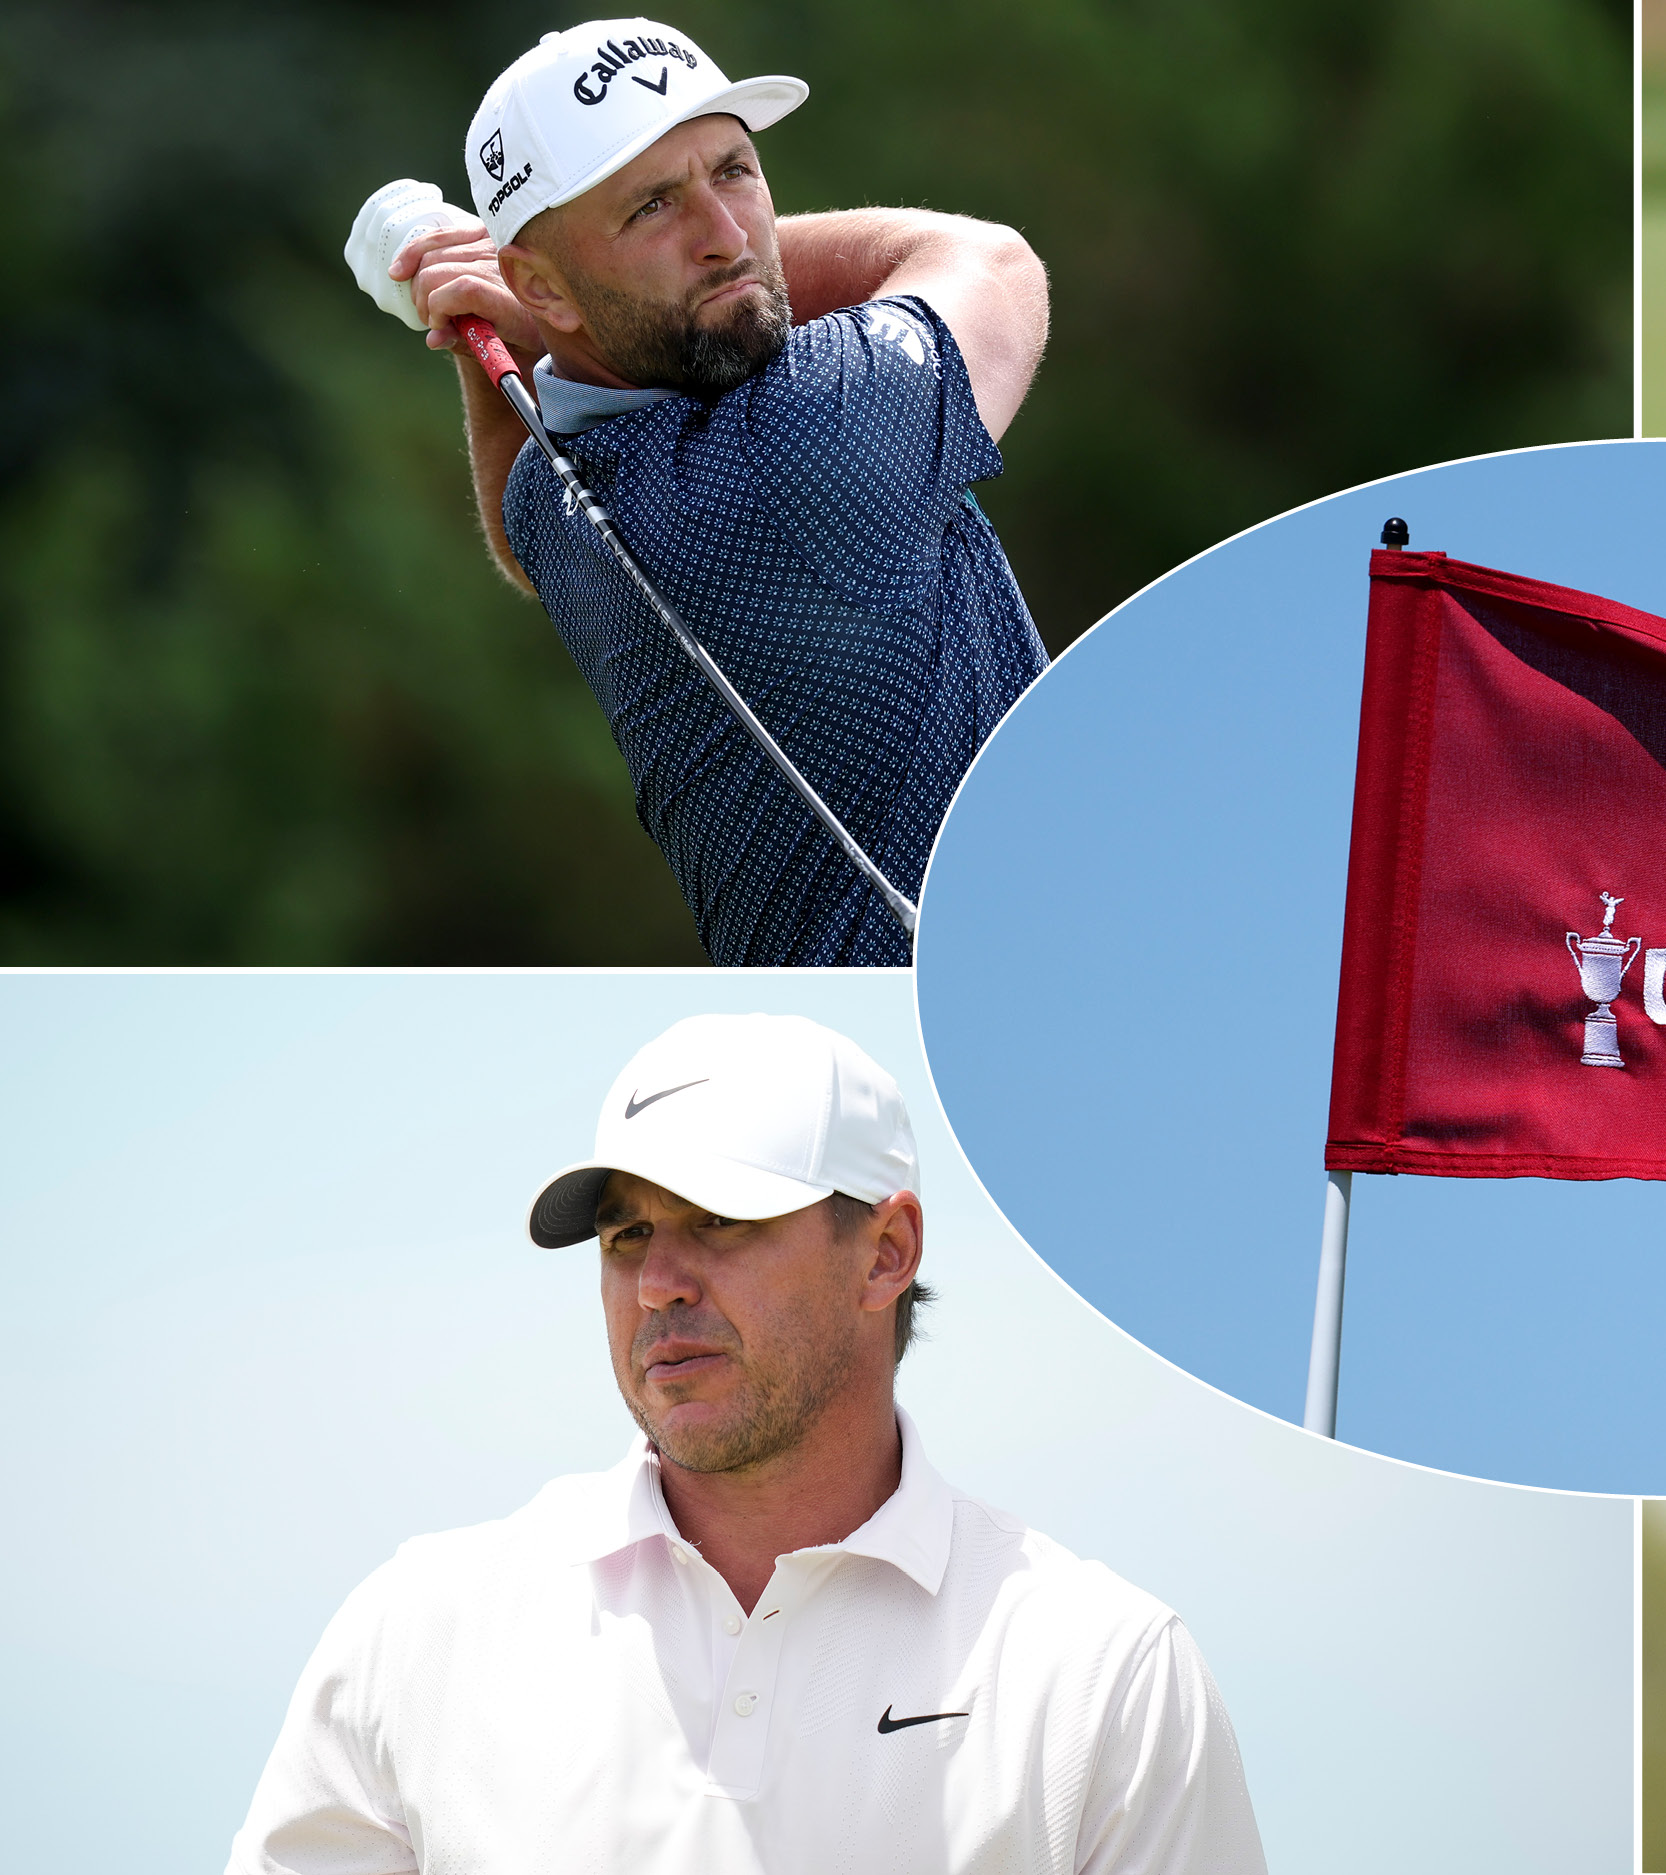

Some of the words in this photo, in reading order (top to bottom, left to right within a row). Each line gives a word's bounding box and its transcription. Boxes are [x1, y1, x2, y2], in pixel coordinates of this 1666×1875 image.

[573, 36, 698, 106] Callaway
[488, 162, 533, 217] TOPGOLF
[614, 543, 671, 627] VENTUS
